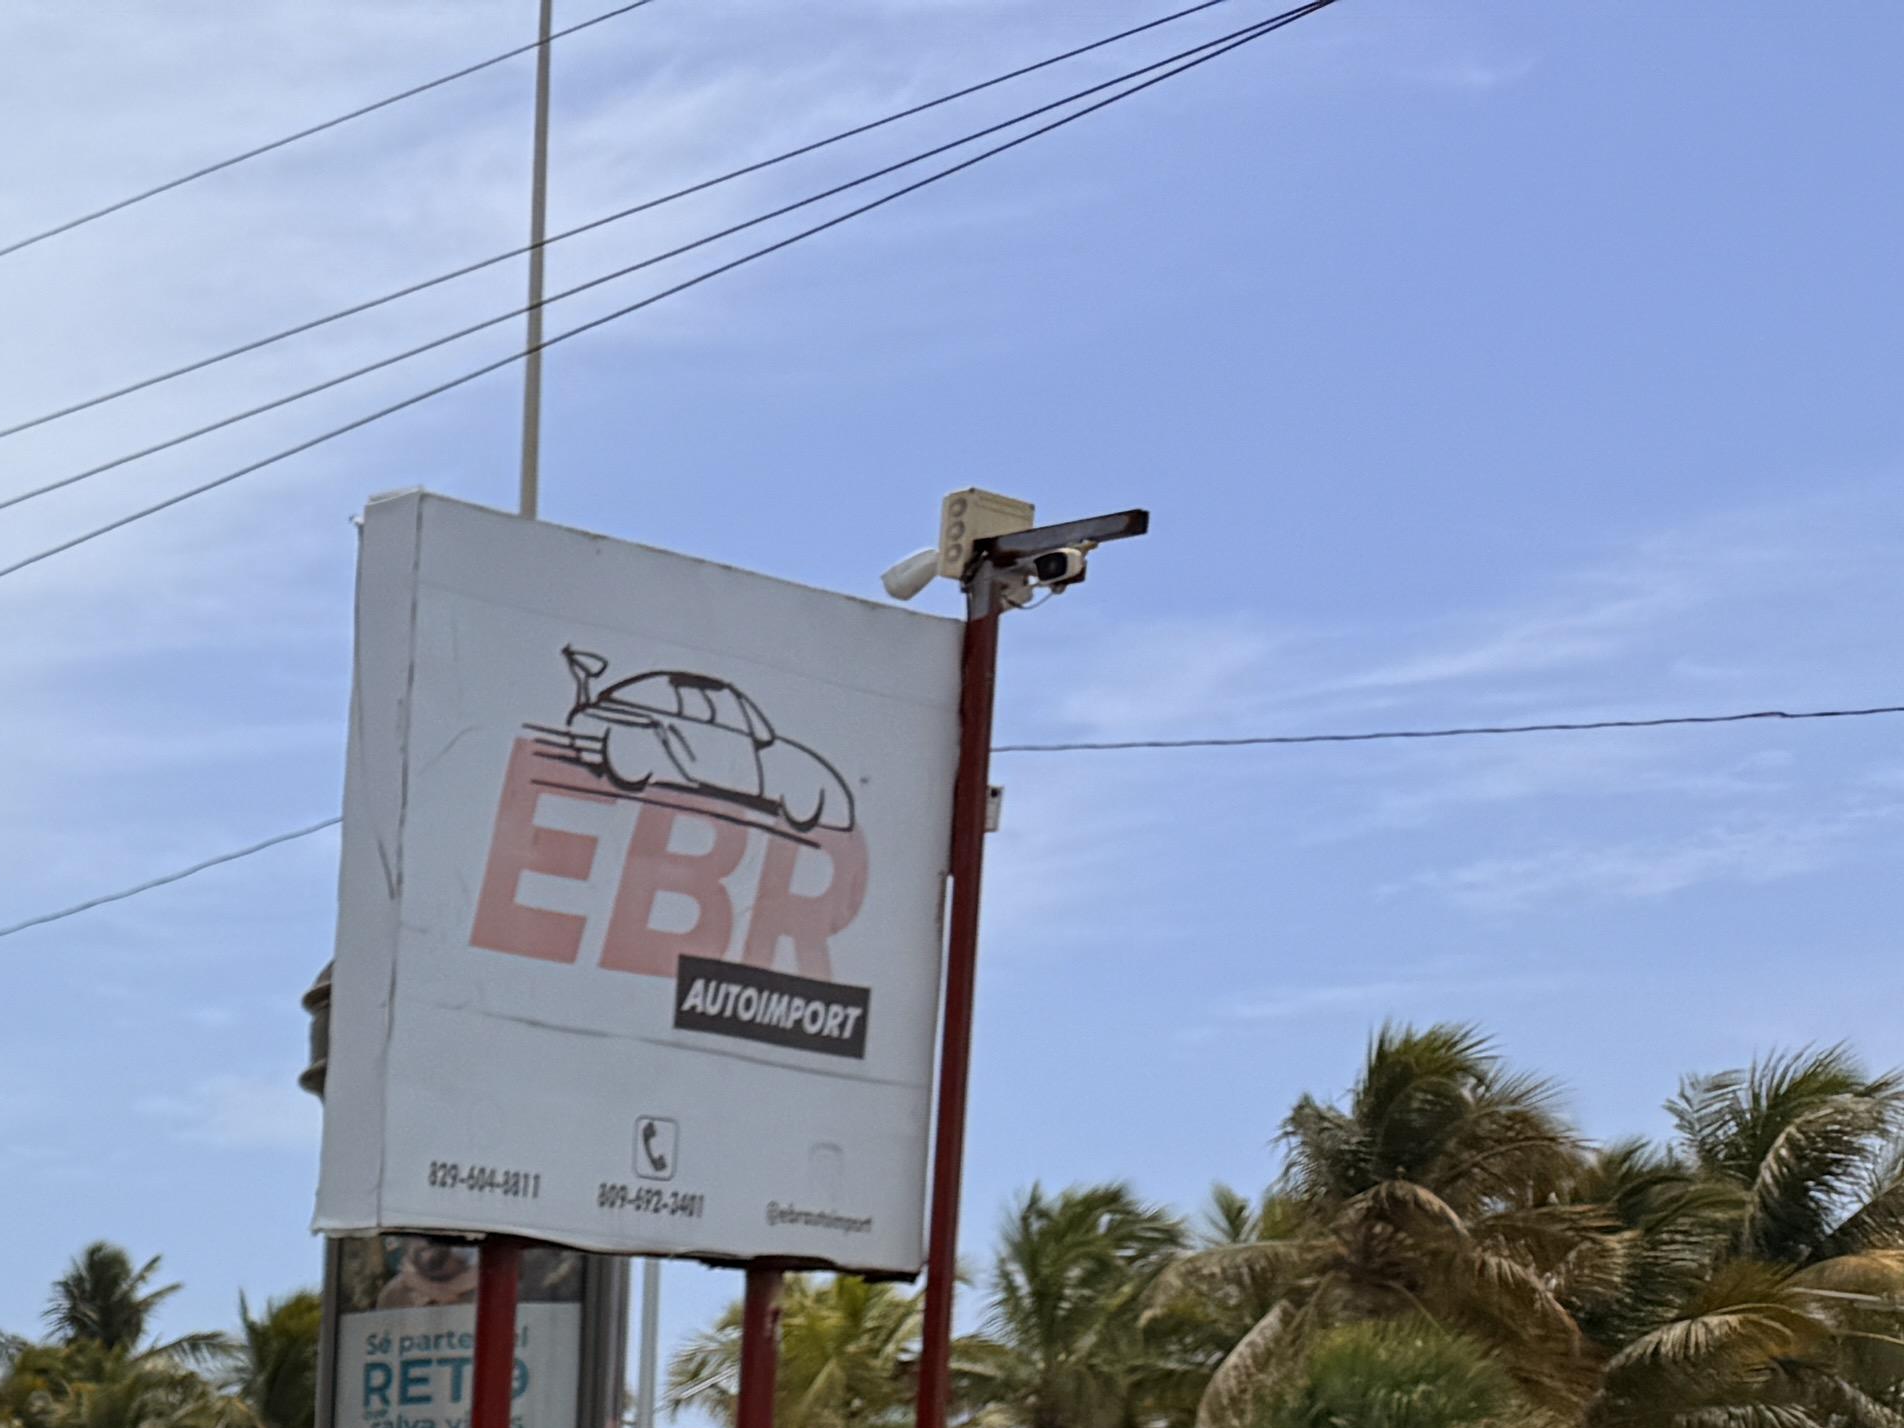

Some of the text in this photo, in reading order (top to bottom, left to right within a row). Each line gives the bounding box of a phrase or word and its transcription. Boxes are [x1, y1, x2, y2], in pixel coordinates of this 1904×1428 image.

[468, 735, 869, 983] EBR
[681, 978, 861, 1040] AUTOIMPORT
[429, 1161, 540, 1199] 829-604-8811
[399, 1330, 474, 1356] parte
